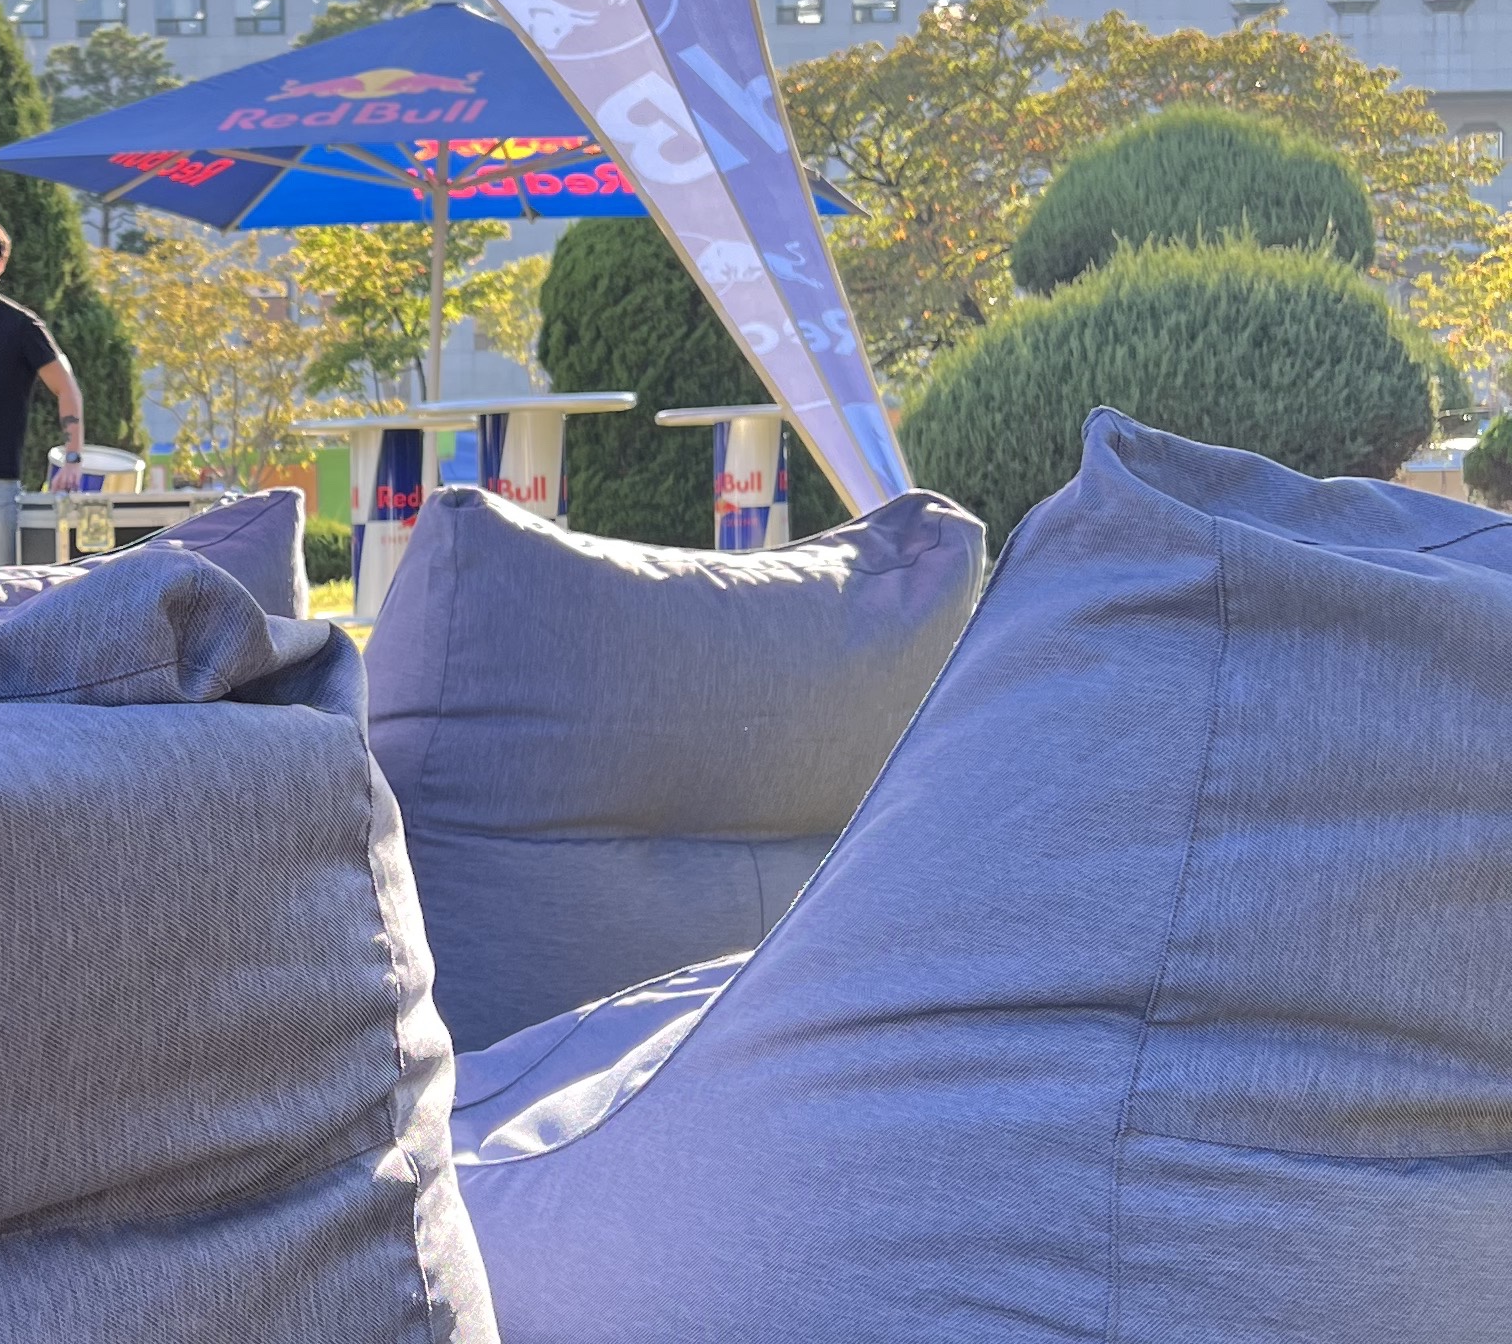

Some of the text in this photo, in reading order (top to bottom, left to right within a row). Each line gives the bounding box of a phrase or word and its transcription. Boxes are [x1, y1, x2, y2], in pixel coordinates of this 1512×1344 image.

[217, 98, 488, 131] Red Bull
[376, 484, 425, 510] Red
